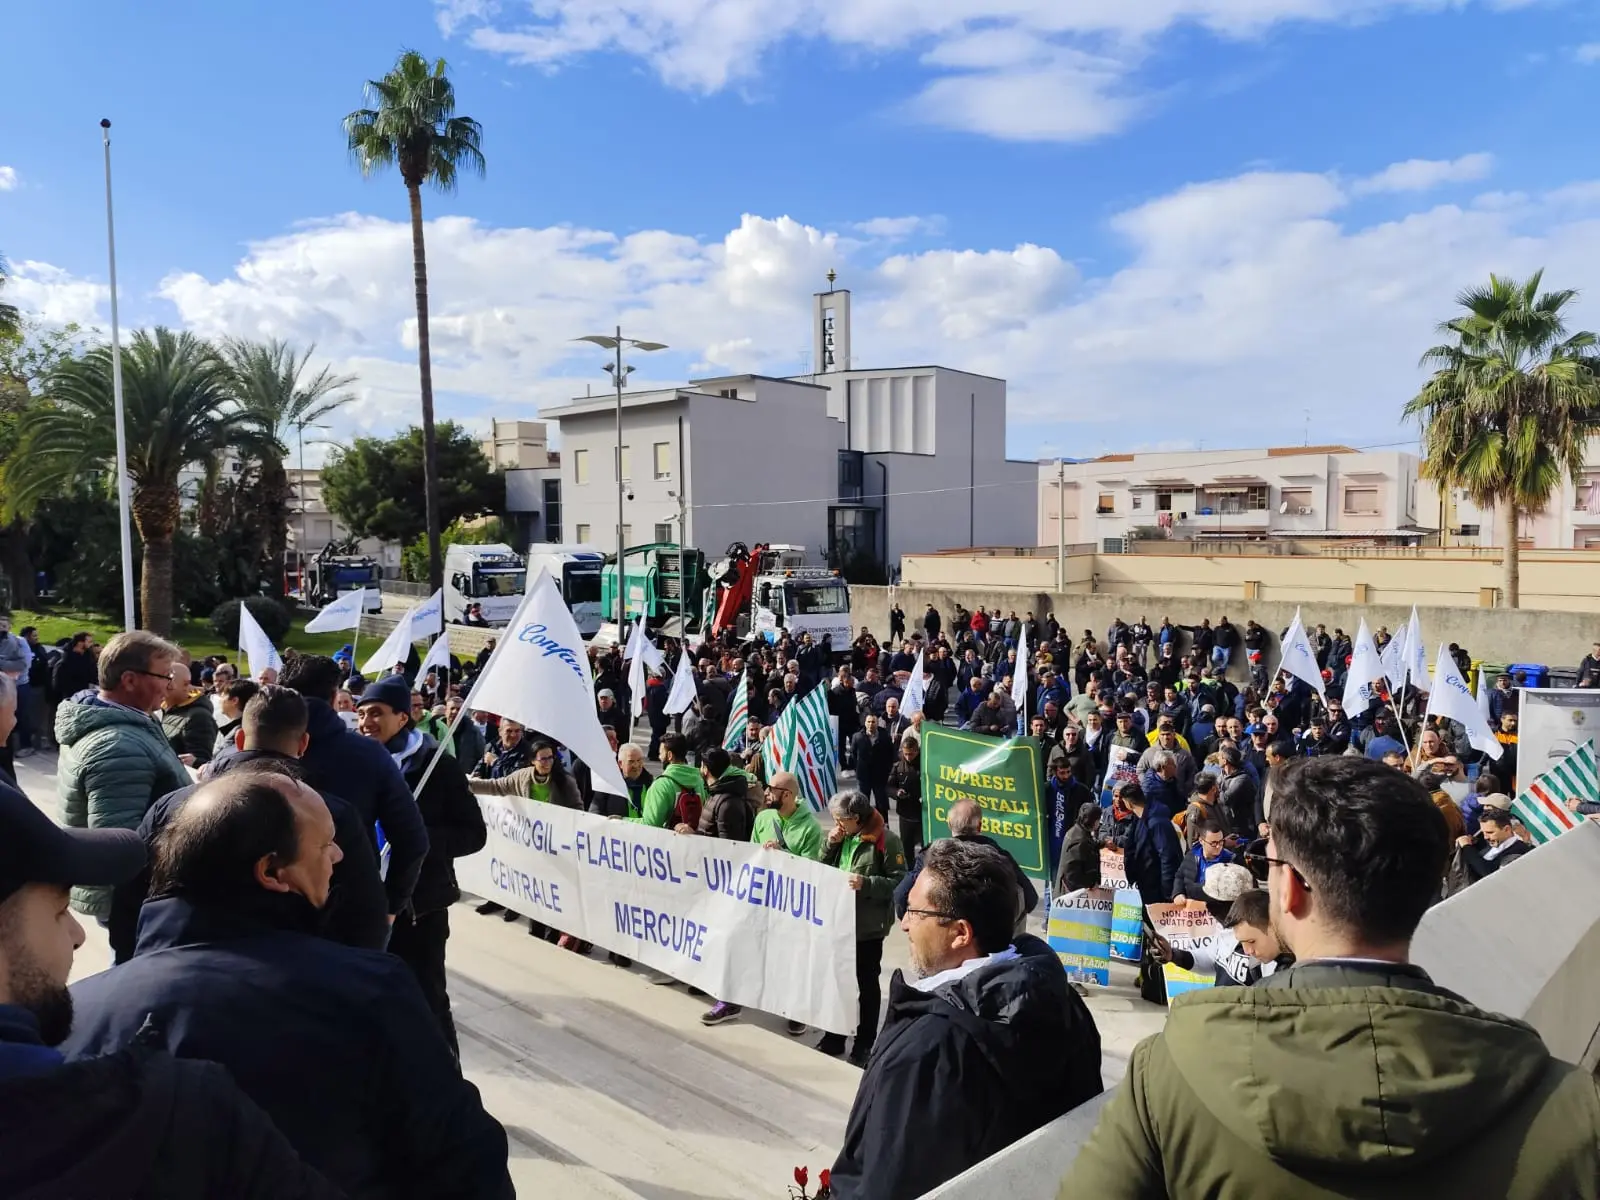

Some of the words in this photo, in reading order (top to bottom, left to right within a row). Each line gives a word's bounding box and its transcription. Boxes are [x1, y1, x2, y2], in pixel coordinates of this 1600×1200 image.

[813, 736, 824, 761] CISL
[939, 764, 1016, 792] IMPRESE
[934, 807, 1033, 840] CBRESI
[490, 857, 562, 914] CENTRALE
[575, 830, 681, 884] FLAEI/CISL
[703, 856, 824, 926] UILCEM/UIL
[1162, 910, 1183, 919] NON
[614, 901, 708, 962] MERCURE
